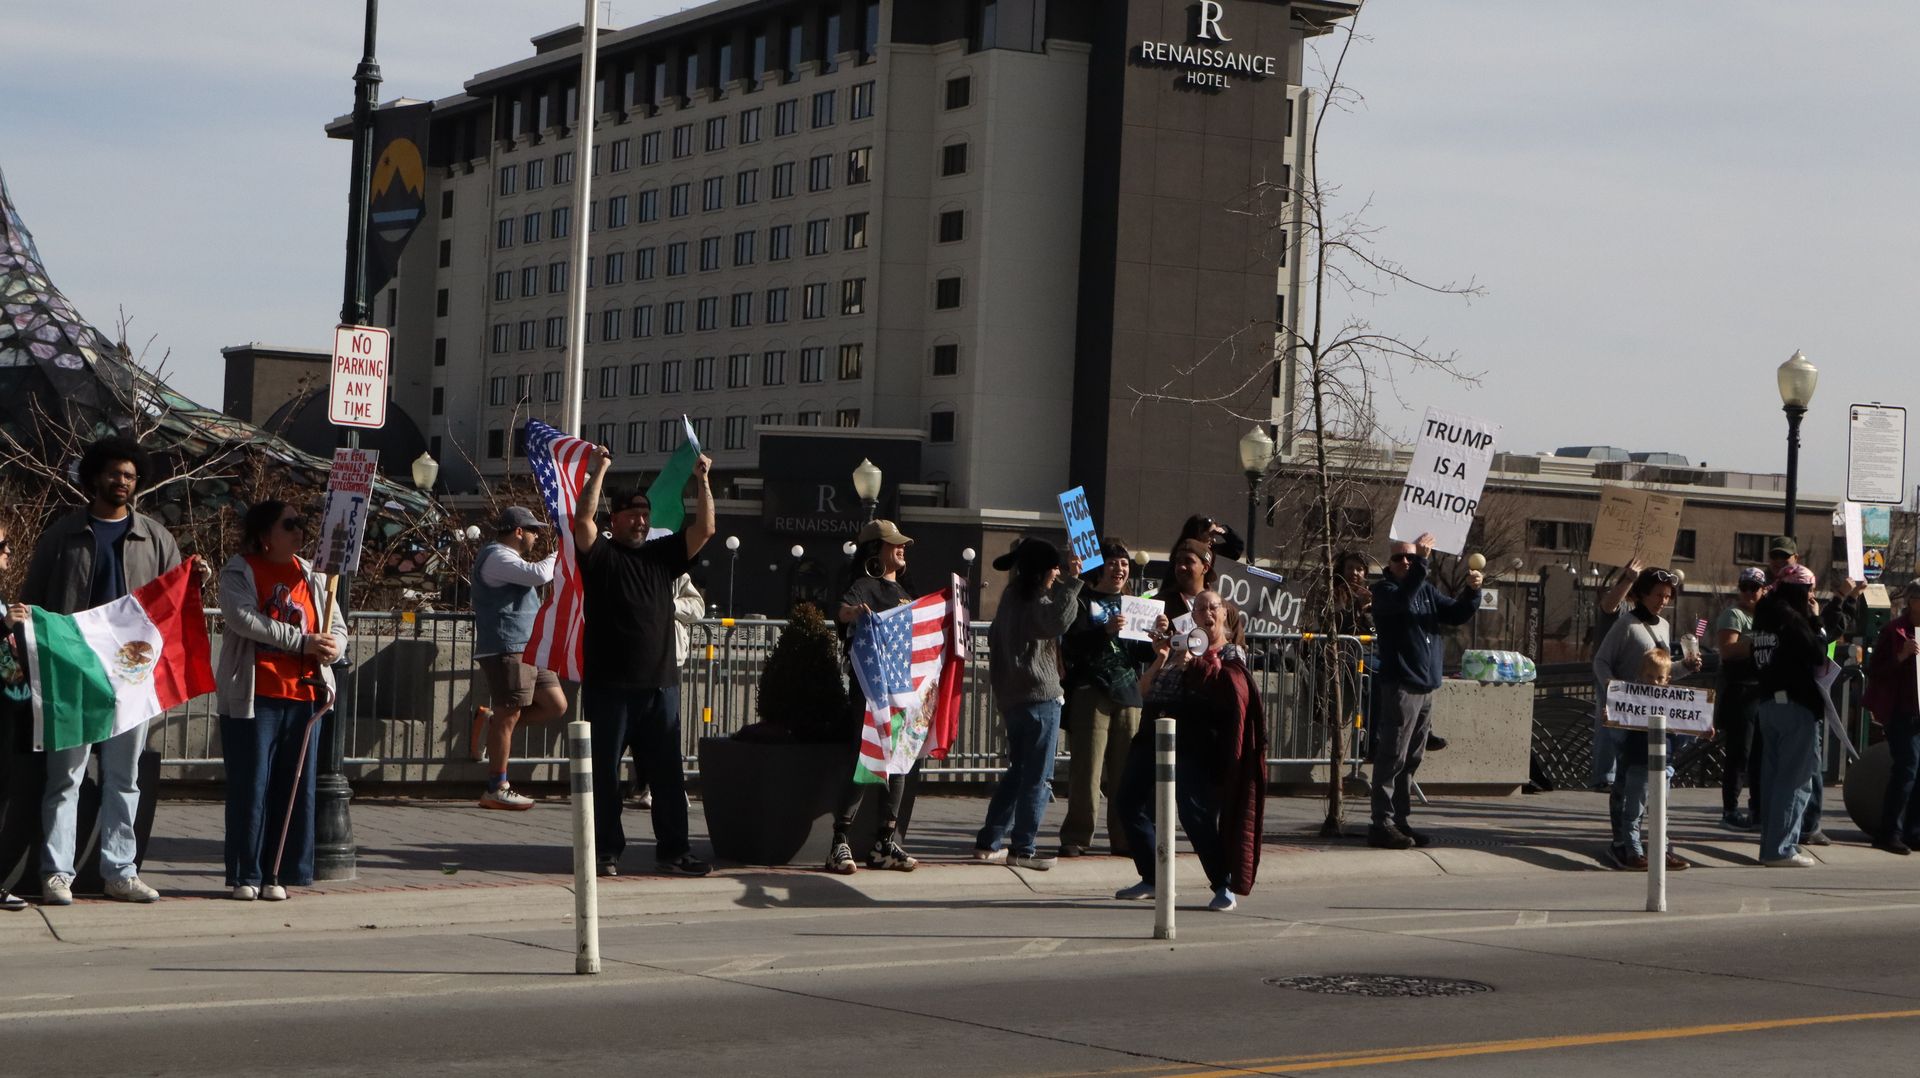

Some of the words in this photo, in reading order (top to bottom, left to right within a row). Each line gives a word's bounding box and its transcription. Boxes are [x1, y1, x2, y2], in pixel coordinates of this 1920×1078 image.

[1197, 0, 1232, 42] R
[1142, 41, 1276, 75] RENAISSANCE
[1187, 71, 1231, 88] HOTEL
[352, 335, 372, 355] NO
[337, 356, 384, 380] PARKING
[346, 381, 372, 397] ANY
[344, 400, 372, 418] TIME
[1426, 419, 1493, 450] TRUMP
[1433, 456, 1451, 475] IS
[1453, 462, 1466, 480] A
[816, 484, 842, 513] R
[1063, 493, 1091, 527] FUCK
[1403, 484, 1478, 517] TRAITOR
[343, 496, 364, 572] TRUMP
[1073, 529, 1101, 561] ICE
[1218, 574, 1250, 605] DO
[1259, 586, 1305, 626] NOT
[1625, 684, 1695, 702] IMMIGRANTS
[1615, 701, 1647, 716] MAKE
[1650, 706, 1665, 716] US
[1669, 708, 1702, 720] GREAT
